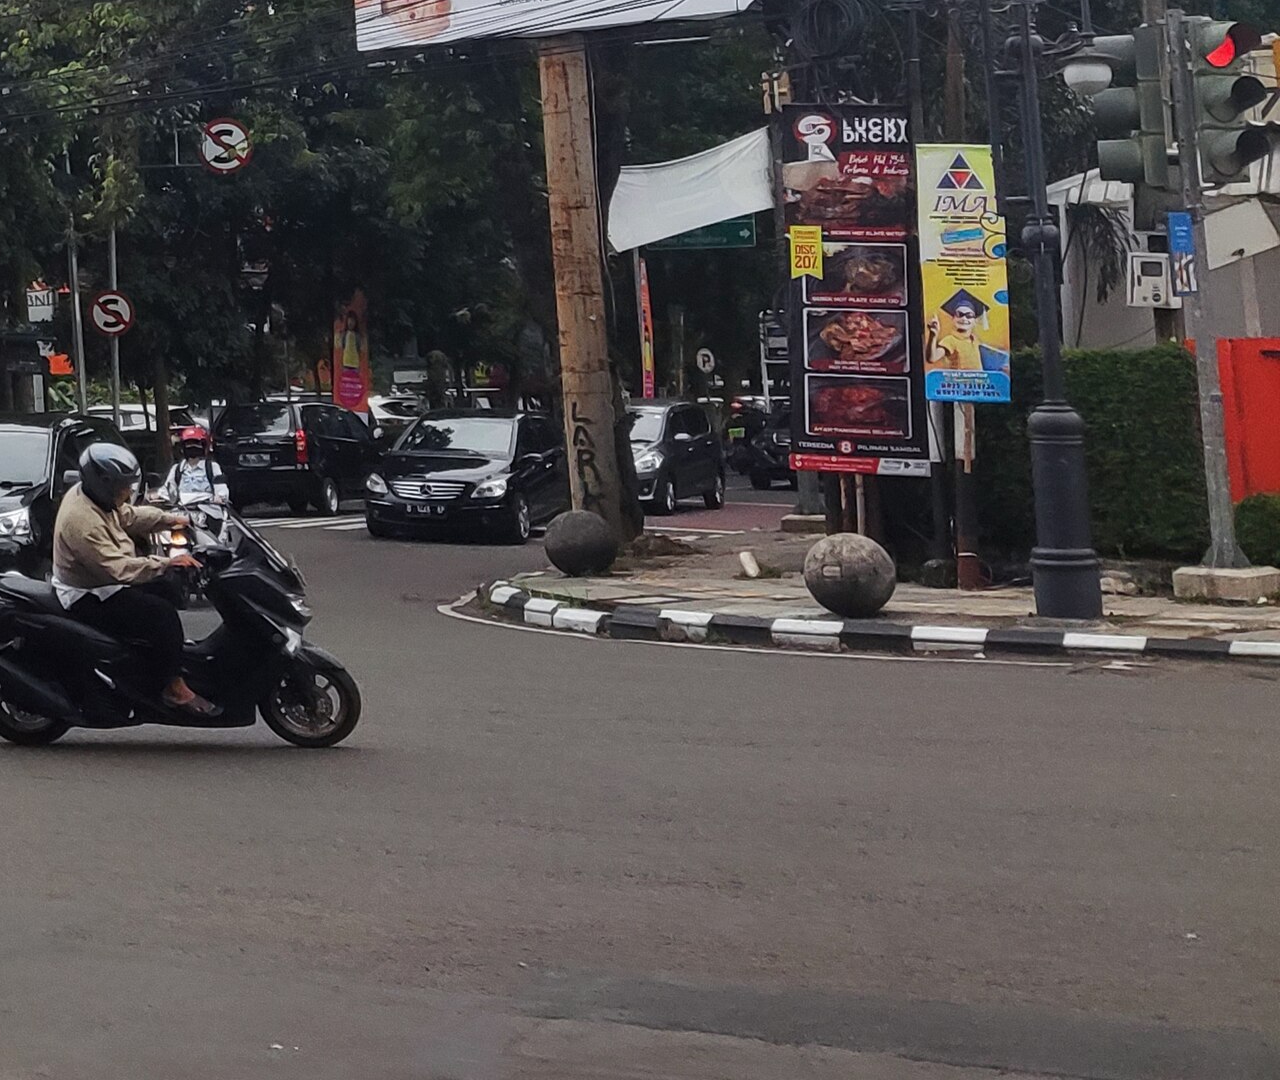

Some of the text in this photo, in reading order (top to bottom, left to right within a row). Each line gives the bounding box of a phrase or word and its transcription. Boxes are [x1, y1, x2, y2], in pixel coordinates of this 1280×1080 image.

[933, 193, 988, 212] IMA
[794, 255, 818, 269] 20%
[841, 441, 852, 453] 8
